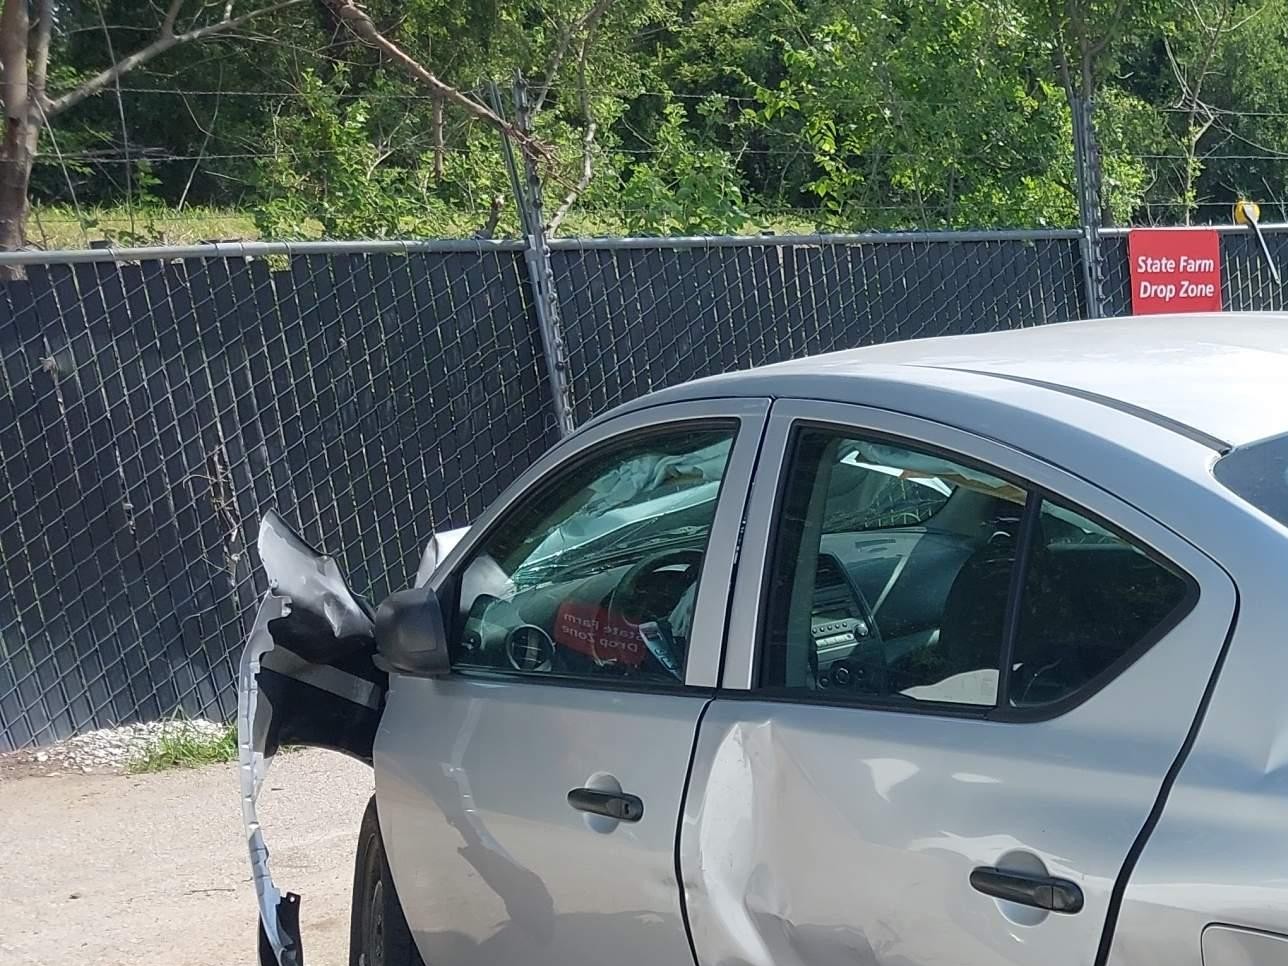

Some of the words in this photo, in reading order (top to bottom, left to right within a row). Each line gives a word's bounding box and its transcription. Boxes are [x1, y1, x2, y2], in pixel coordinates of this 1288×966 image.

[1137, 256, 1176, 273] State
[1179, 256, 1214, 273] Farm
[1140, 281, 1176, 301] Drop
[1179, 281, 1215, 297] Zone
